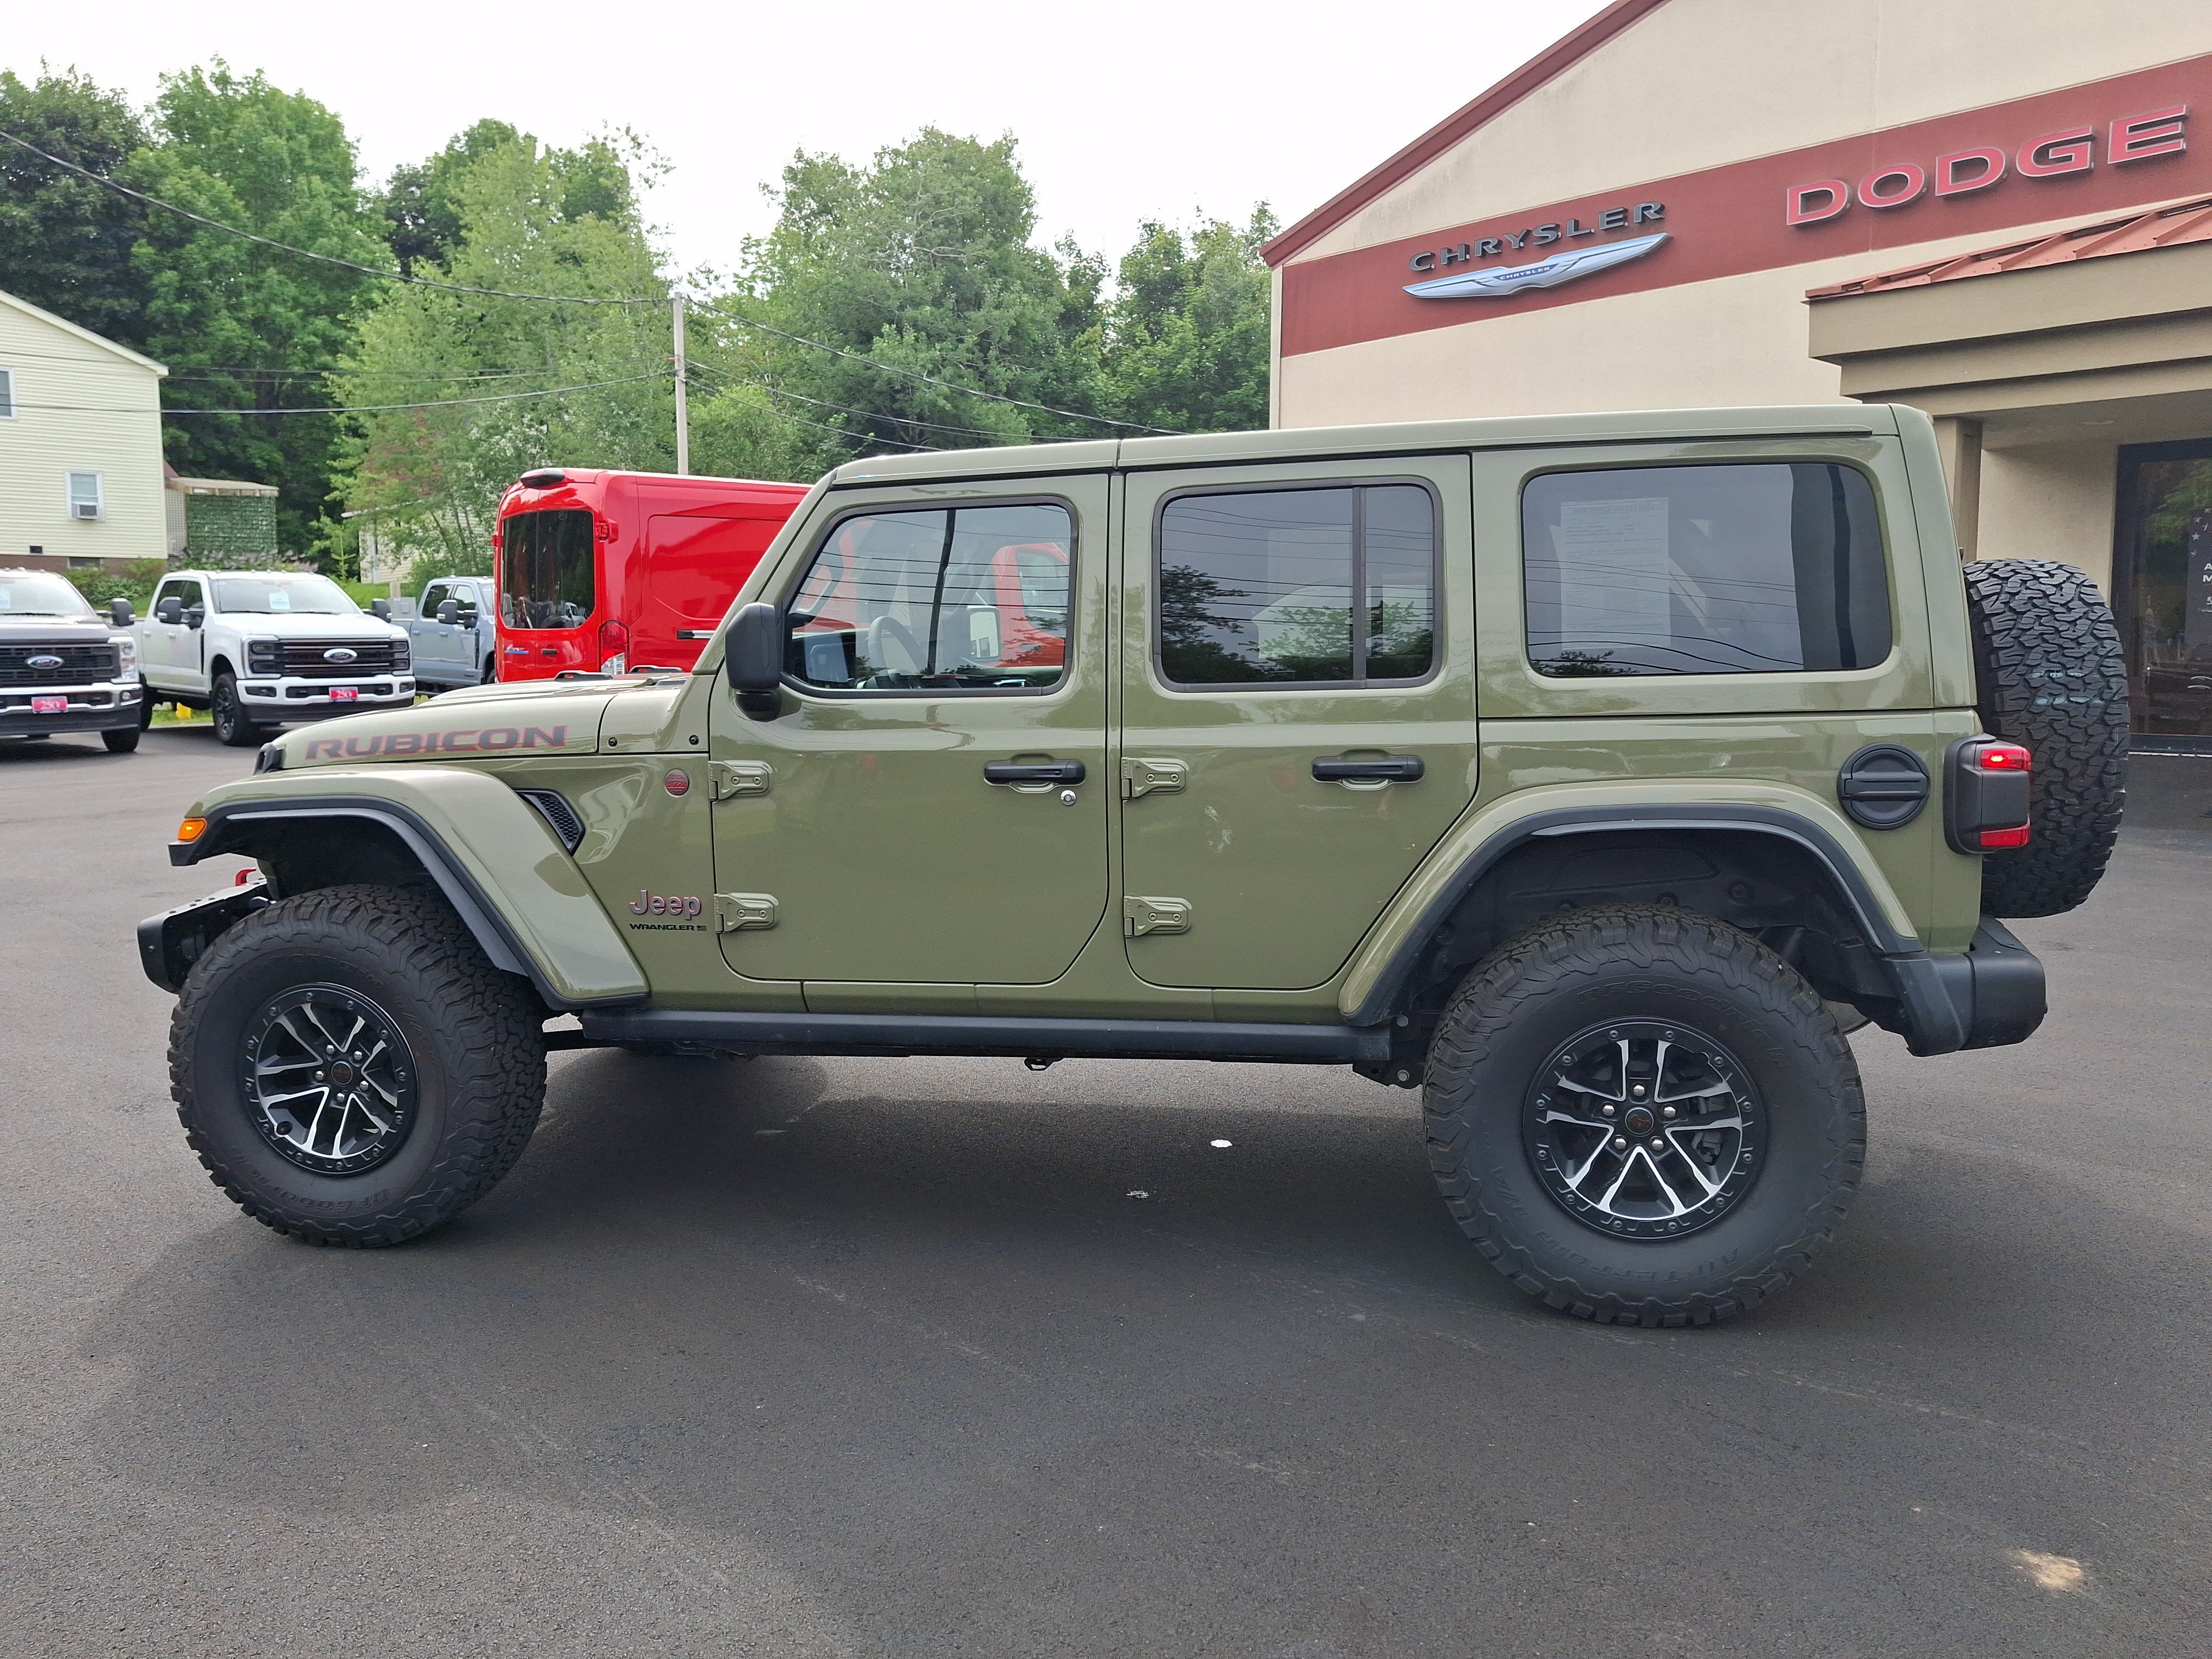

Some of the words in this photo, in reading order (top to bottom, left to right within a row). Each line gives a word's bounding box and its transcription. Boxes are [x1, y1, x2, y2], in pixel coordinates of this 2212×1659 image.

[1786, 105, 2189, 226] DODGE
[1409, 201, 1664, 271] CHRYSLER
[1499, 267, 1550, 280] CHRYSLER
[306, 724, 568, 760] RUBICON
[629, 890, 702, 921] Jeep
[629, 923, 695, 931] WRANGLER
[1576, 980, 1790, 1068] BFGoodrich
